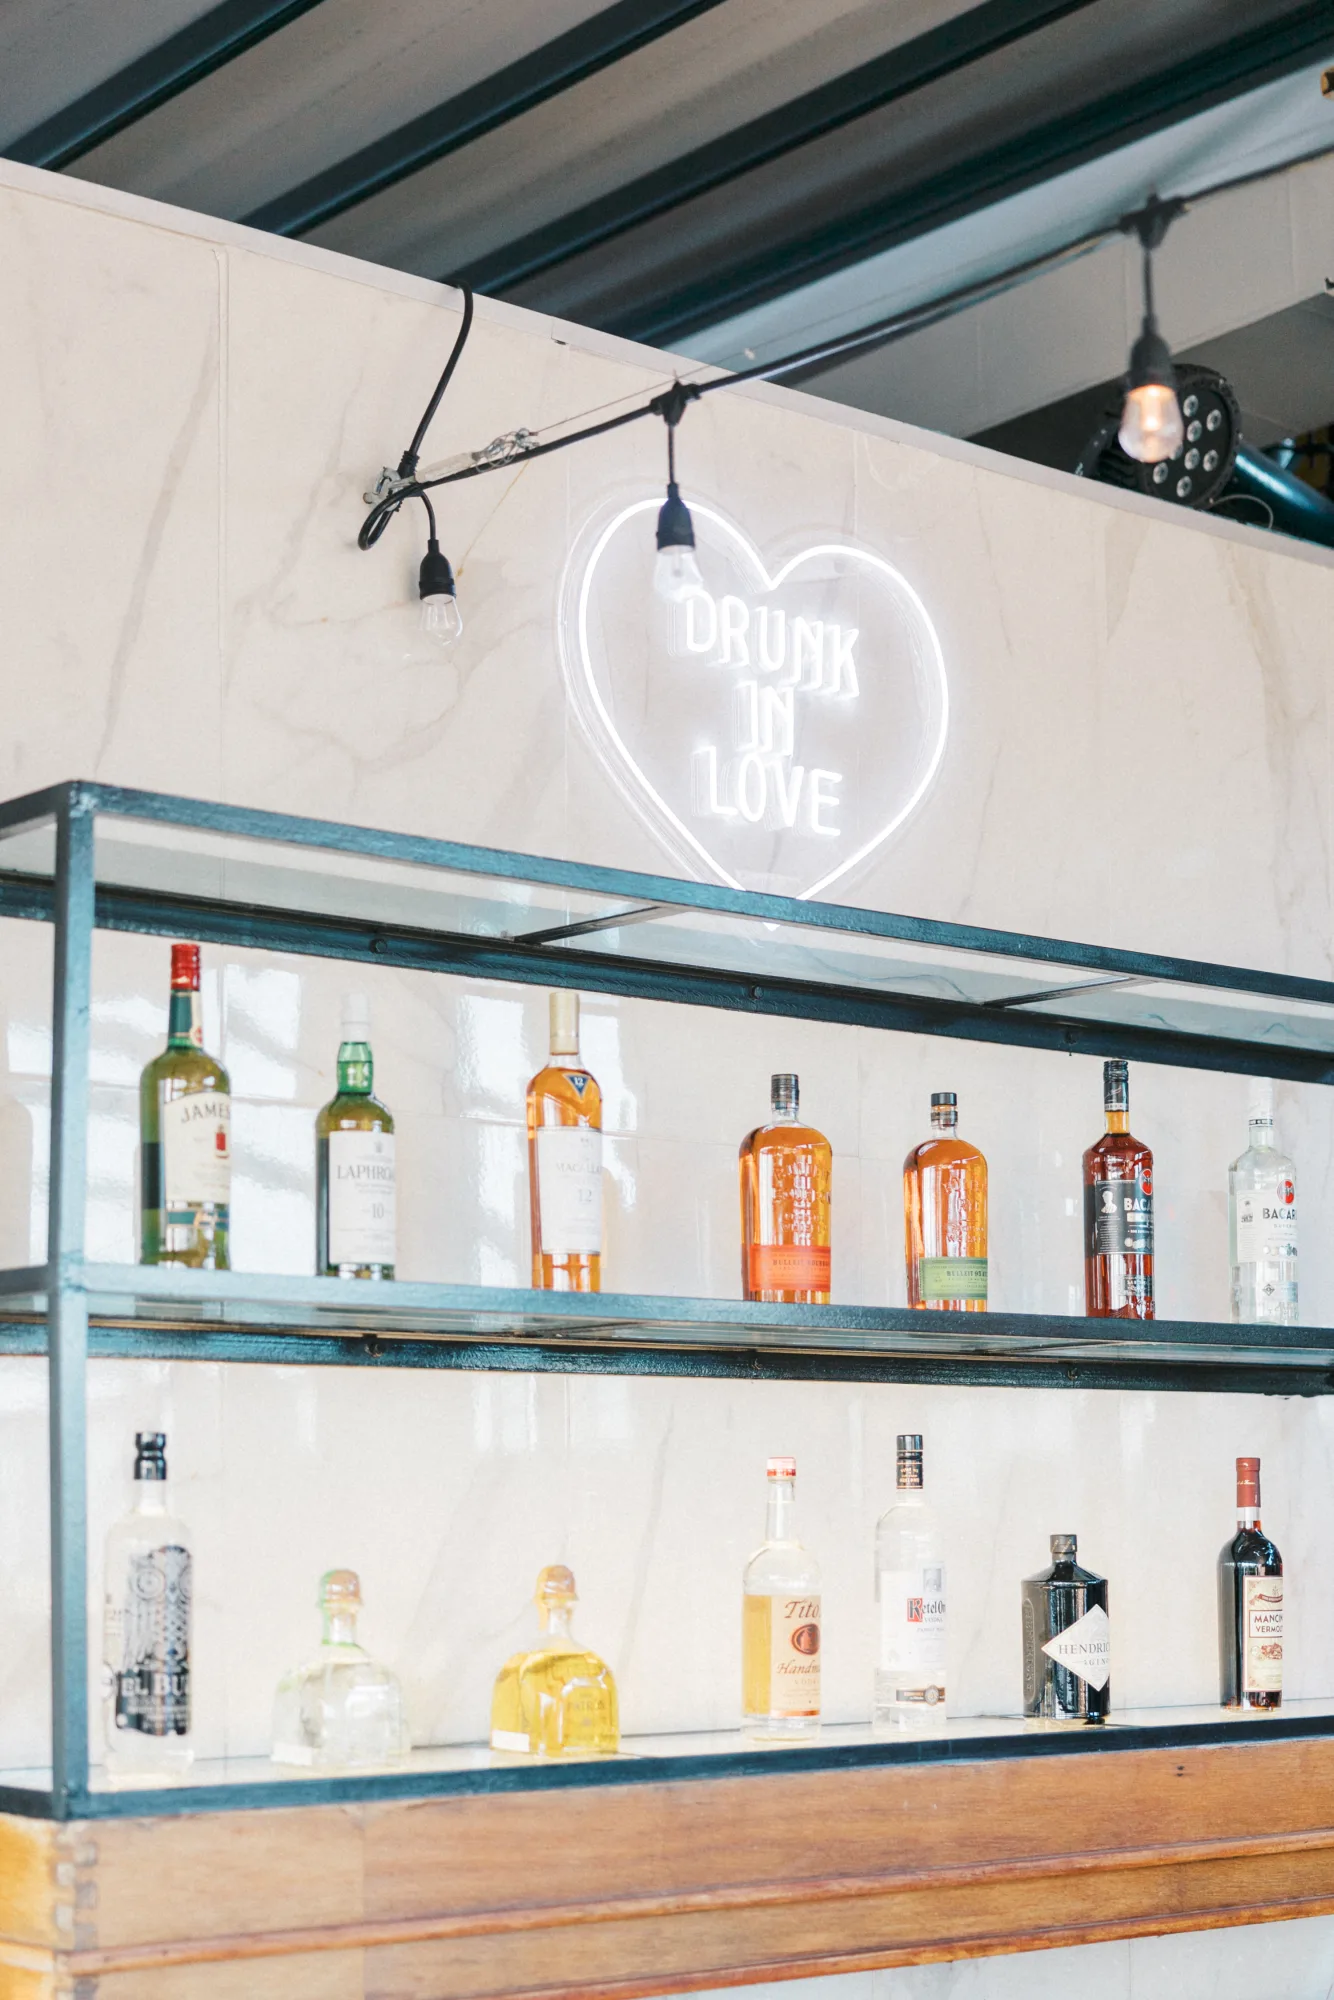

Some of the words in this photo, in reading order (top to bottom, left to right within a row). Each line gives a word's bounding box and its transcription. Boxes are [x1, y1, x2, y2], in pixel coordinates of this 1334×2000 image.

[685, 591, 860, 698] DRUNK
[737, 681, 794, 757] IN
[700, 746, 843, 836] LOVE
[371, 1202, 385, 1219] 10
